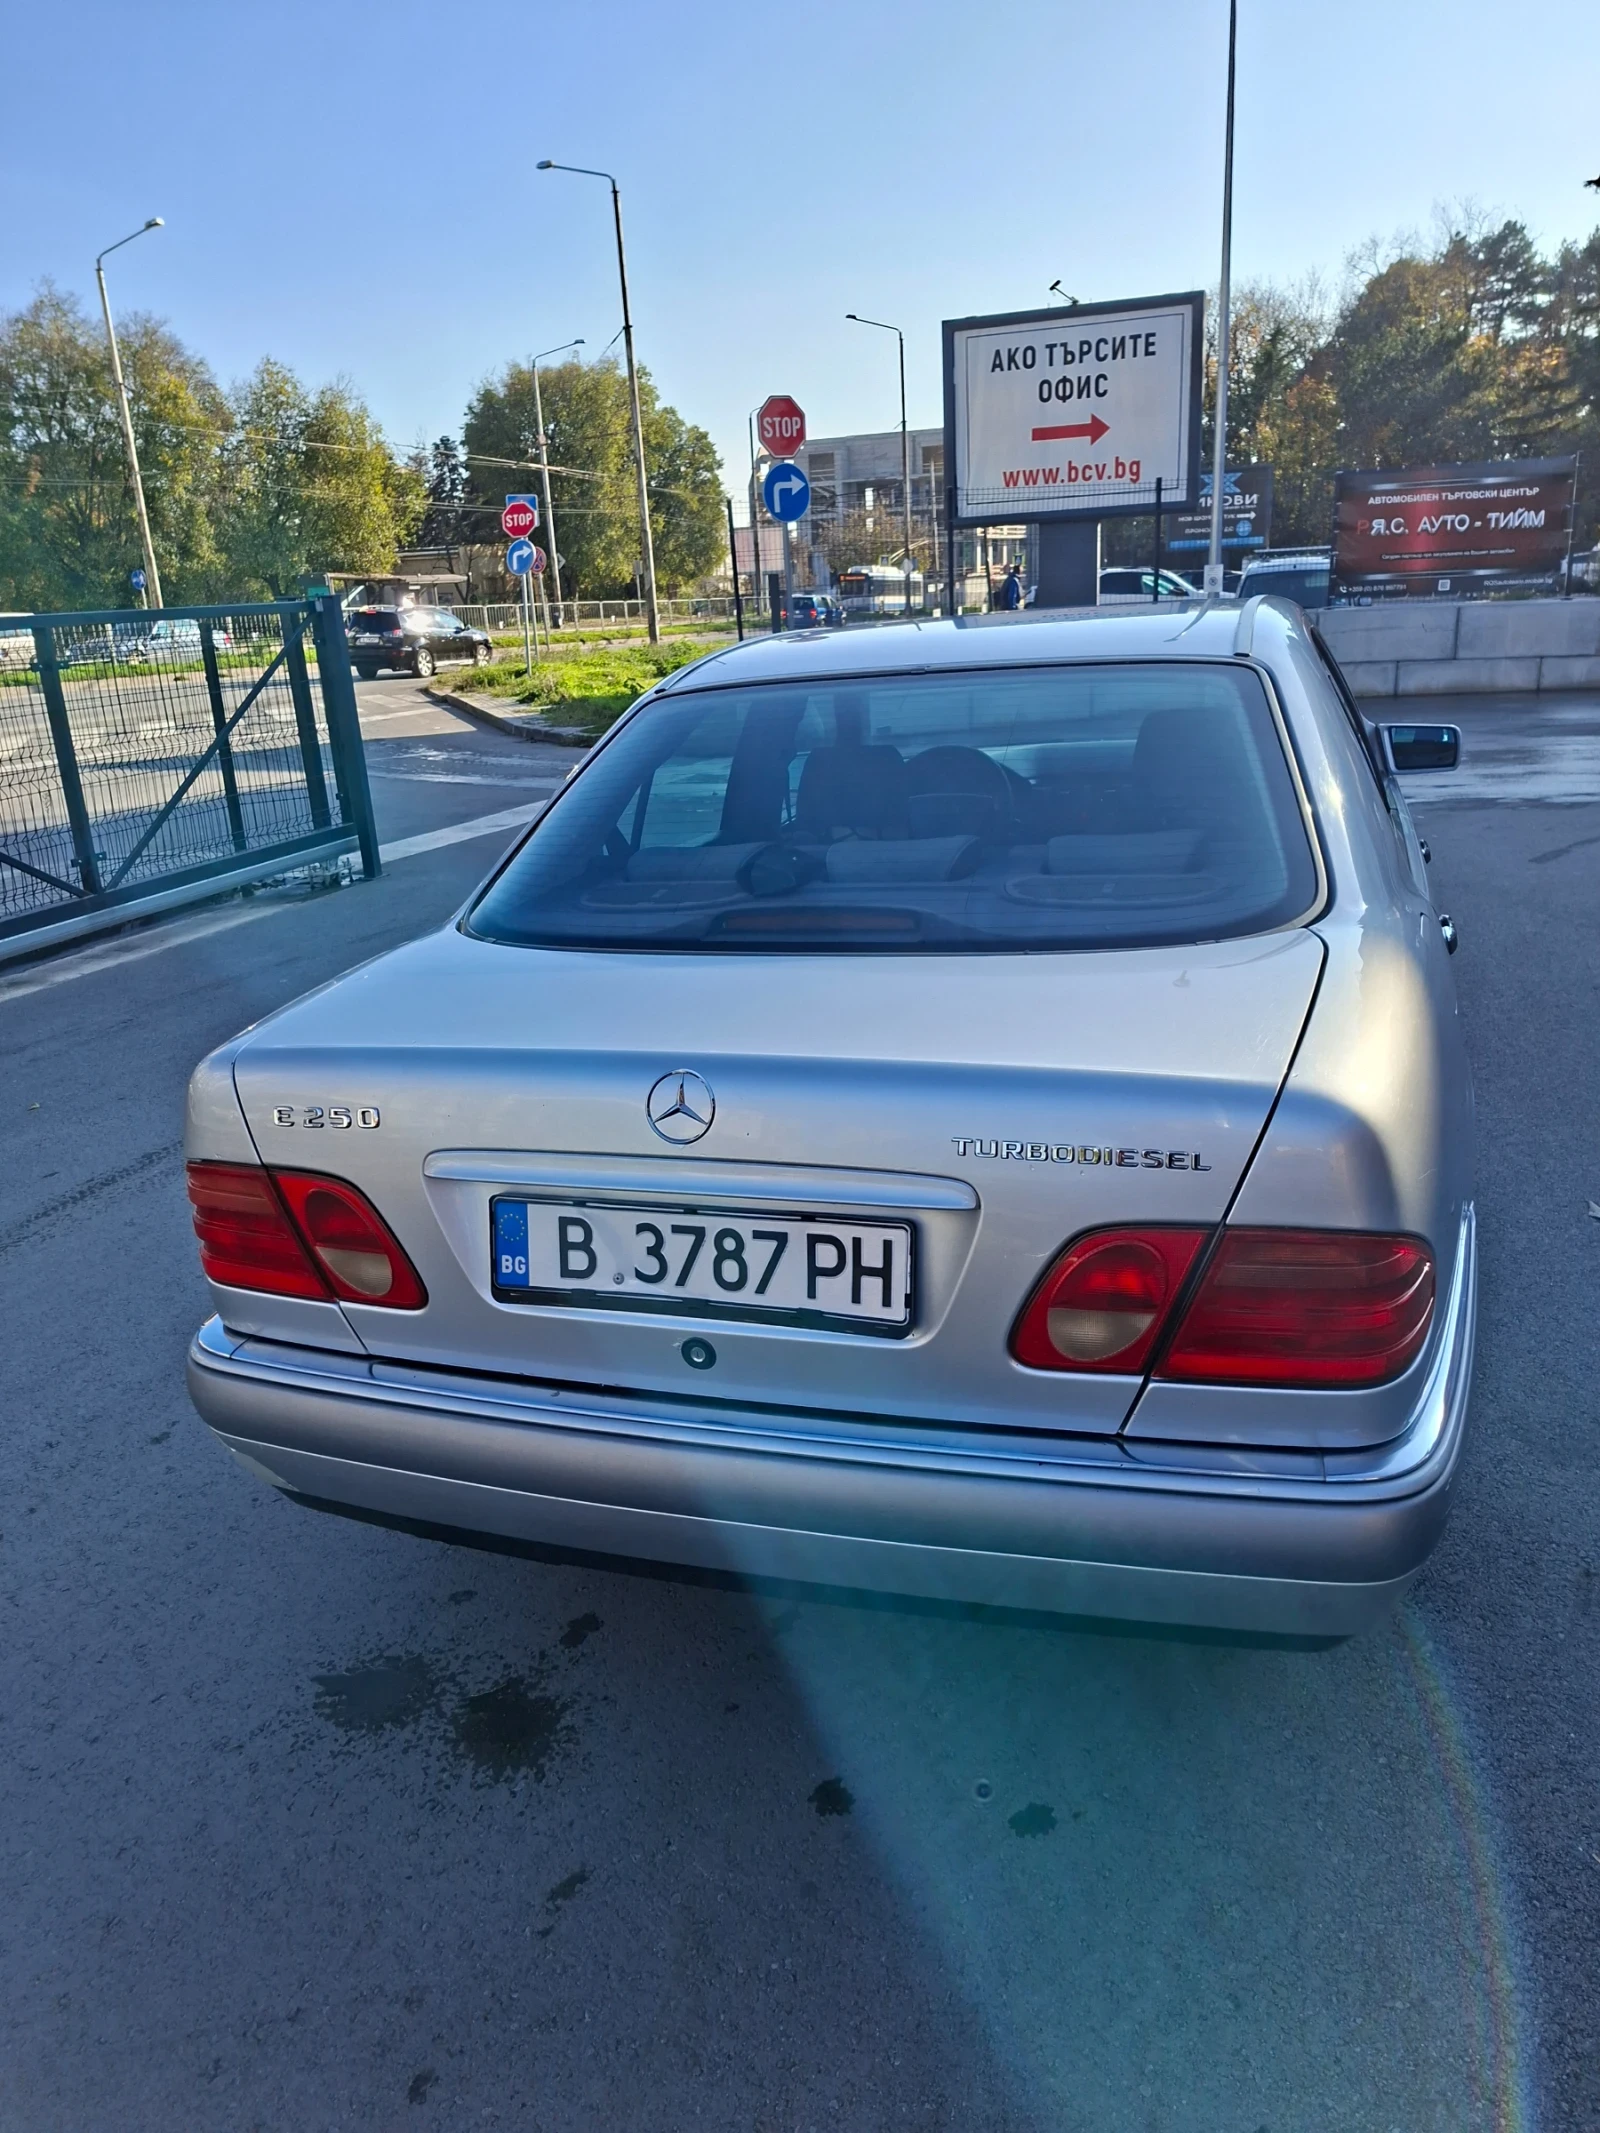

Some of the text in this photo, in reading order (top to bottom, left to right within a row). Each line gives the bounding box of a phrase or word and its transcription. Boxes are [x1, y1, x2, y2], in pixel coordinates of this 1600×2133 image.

[990, 332, 1157, 373] АКО ТЪРСИТЕ
[1038, 373, 1109, 403] ОФИС
[763, 416, 801, 438] STOP
[1003, 456, 1141, 488] www.bcv.bg
[1368, 487, 1540, 505] АВТОМОБИЛЕН ТЪРГОВСКИ ЦЕНТЪР
[505, 512, 533, 527] STOP
[1417, 514, 1470, 533] АУТО
[1487, 507, 1546, 529] ТИЙМ
[273, 1106, 381, 1129] E 250
[951, 1137, 1212, 1172] TURBODIESEL
[501, 1254, 527, 1274] BG
[634, 1221, 789, 1296] 3787
